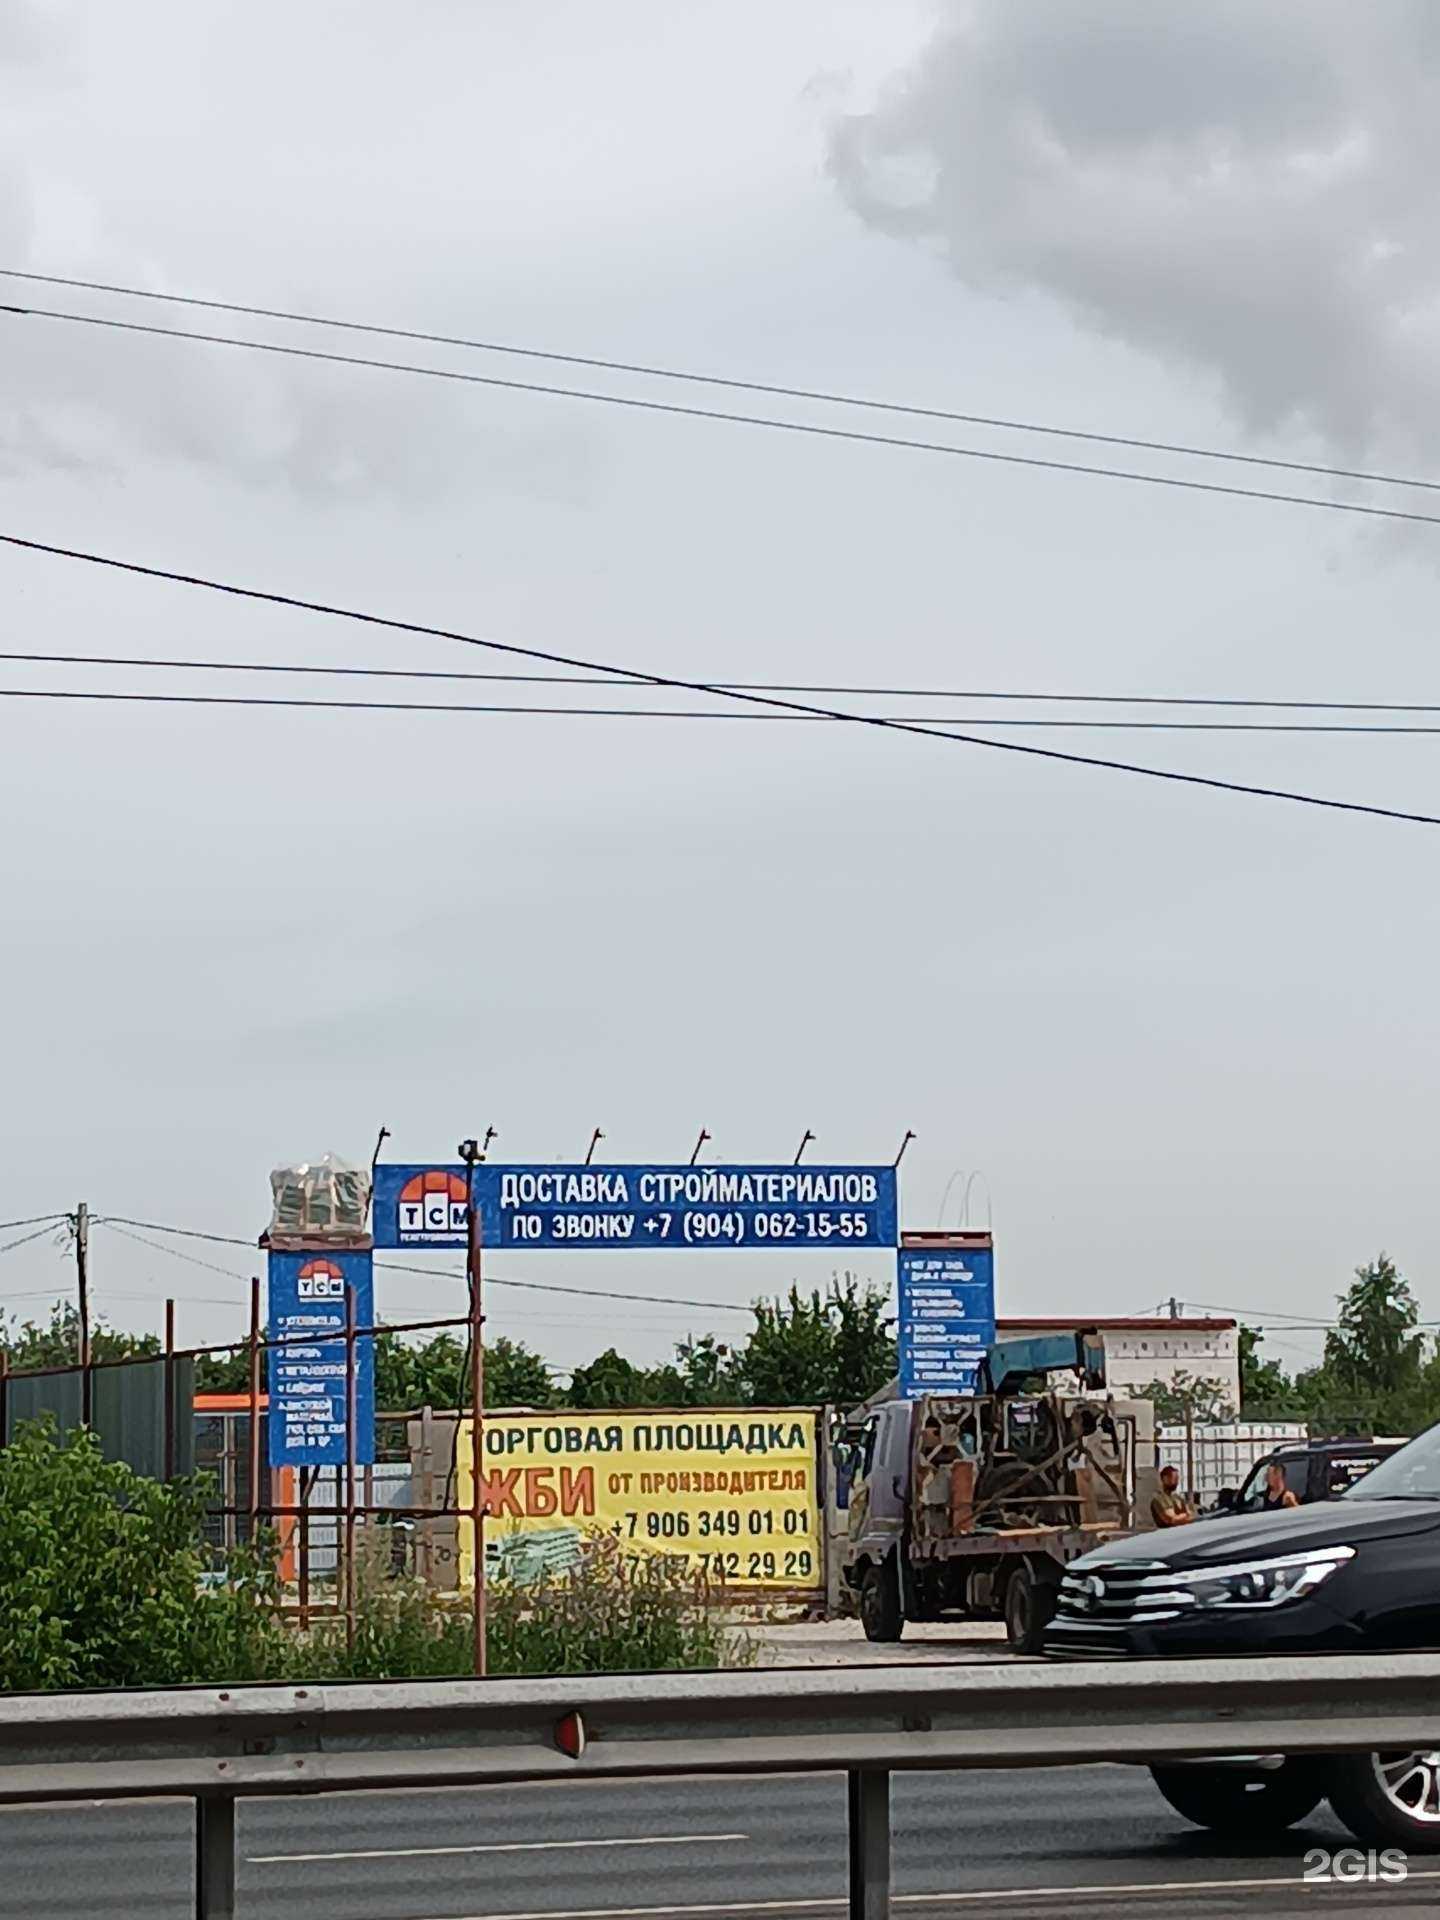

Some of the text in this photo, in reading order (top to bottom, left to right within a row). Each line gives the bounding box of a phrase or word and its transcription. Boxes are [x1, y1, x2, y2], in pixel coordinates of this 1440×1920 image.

[501, 1168, 878, 1209] ДОСТАВКА СТРОЙМАТЕРИАЛОВ
[512, 1211, 868, 1243] ПО ЗВОНКУ +7 (904) 062-15-55
[467, 1423, 806, 1455] ОРГОВАЯ ПЛОЩАДКА
[469, 1466, 807, 1518] ЖБИ ОТ ПРОИЗВОДИТЕЛЯ
[611, 1508, 808, 1538] +7 906 349 01 01
[748, 1552, 776, 1579] 29
[784, 1550, 812, 1577] 29
